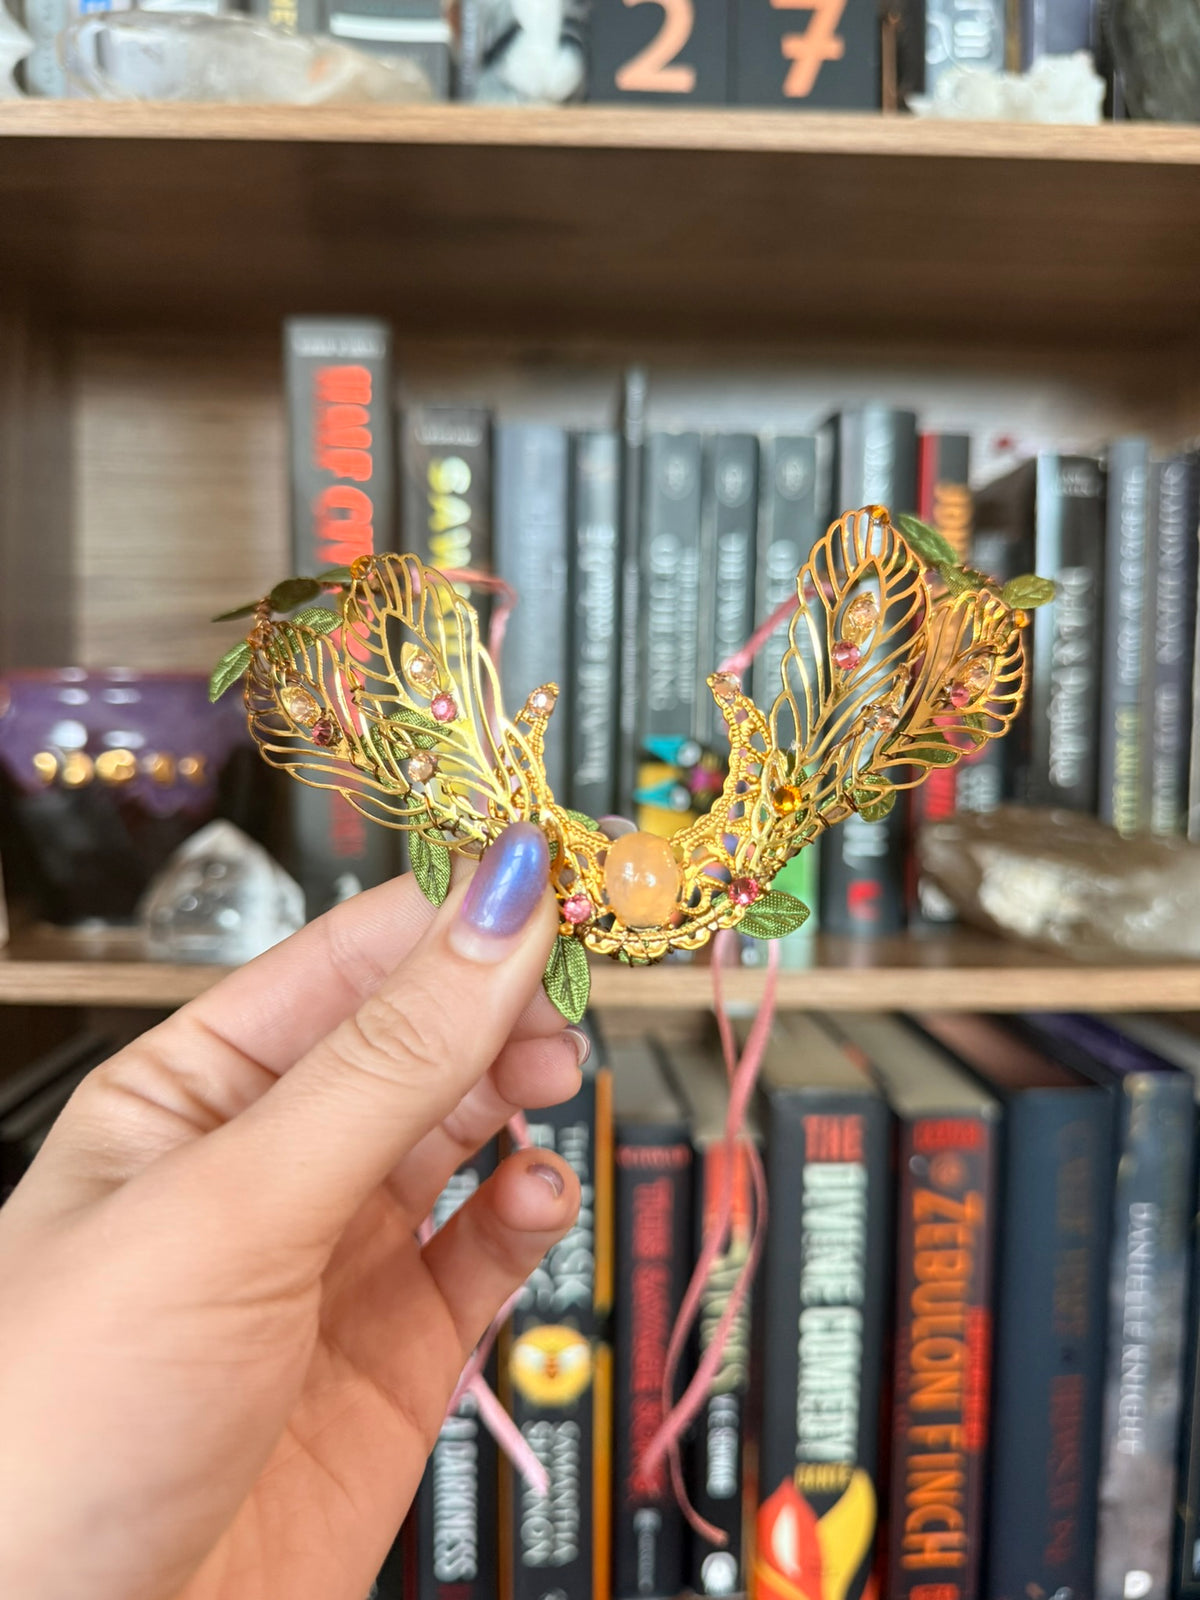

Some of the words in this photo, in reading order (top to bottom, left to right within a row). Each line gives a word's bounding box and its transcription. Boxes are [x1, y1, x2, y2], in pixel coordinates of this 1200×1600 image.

[801, 1162, 867, 1304] DIVINE
[908, 1189, 987, 1411] ZEBULON
[796, 1306, 863, 1462] COMEDY
[433, 1440, 478, 1581] DARKNESS
[550, 1421, 581, 1567] SAMANTHA
[900, 1424, 970, 1568] FINCH
